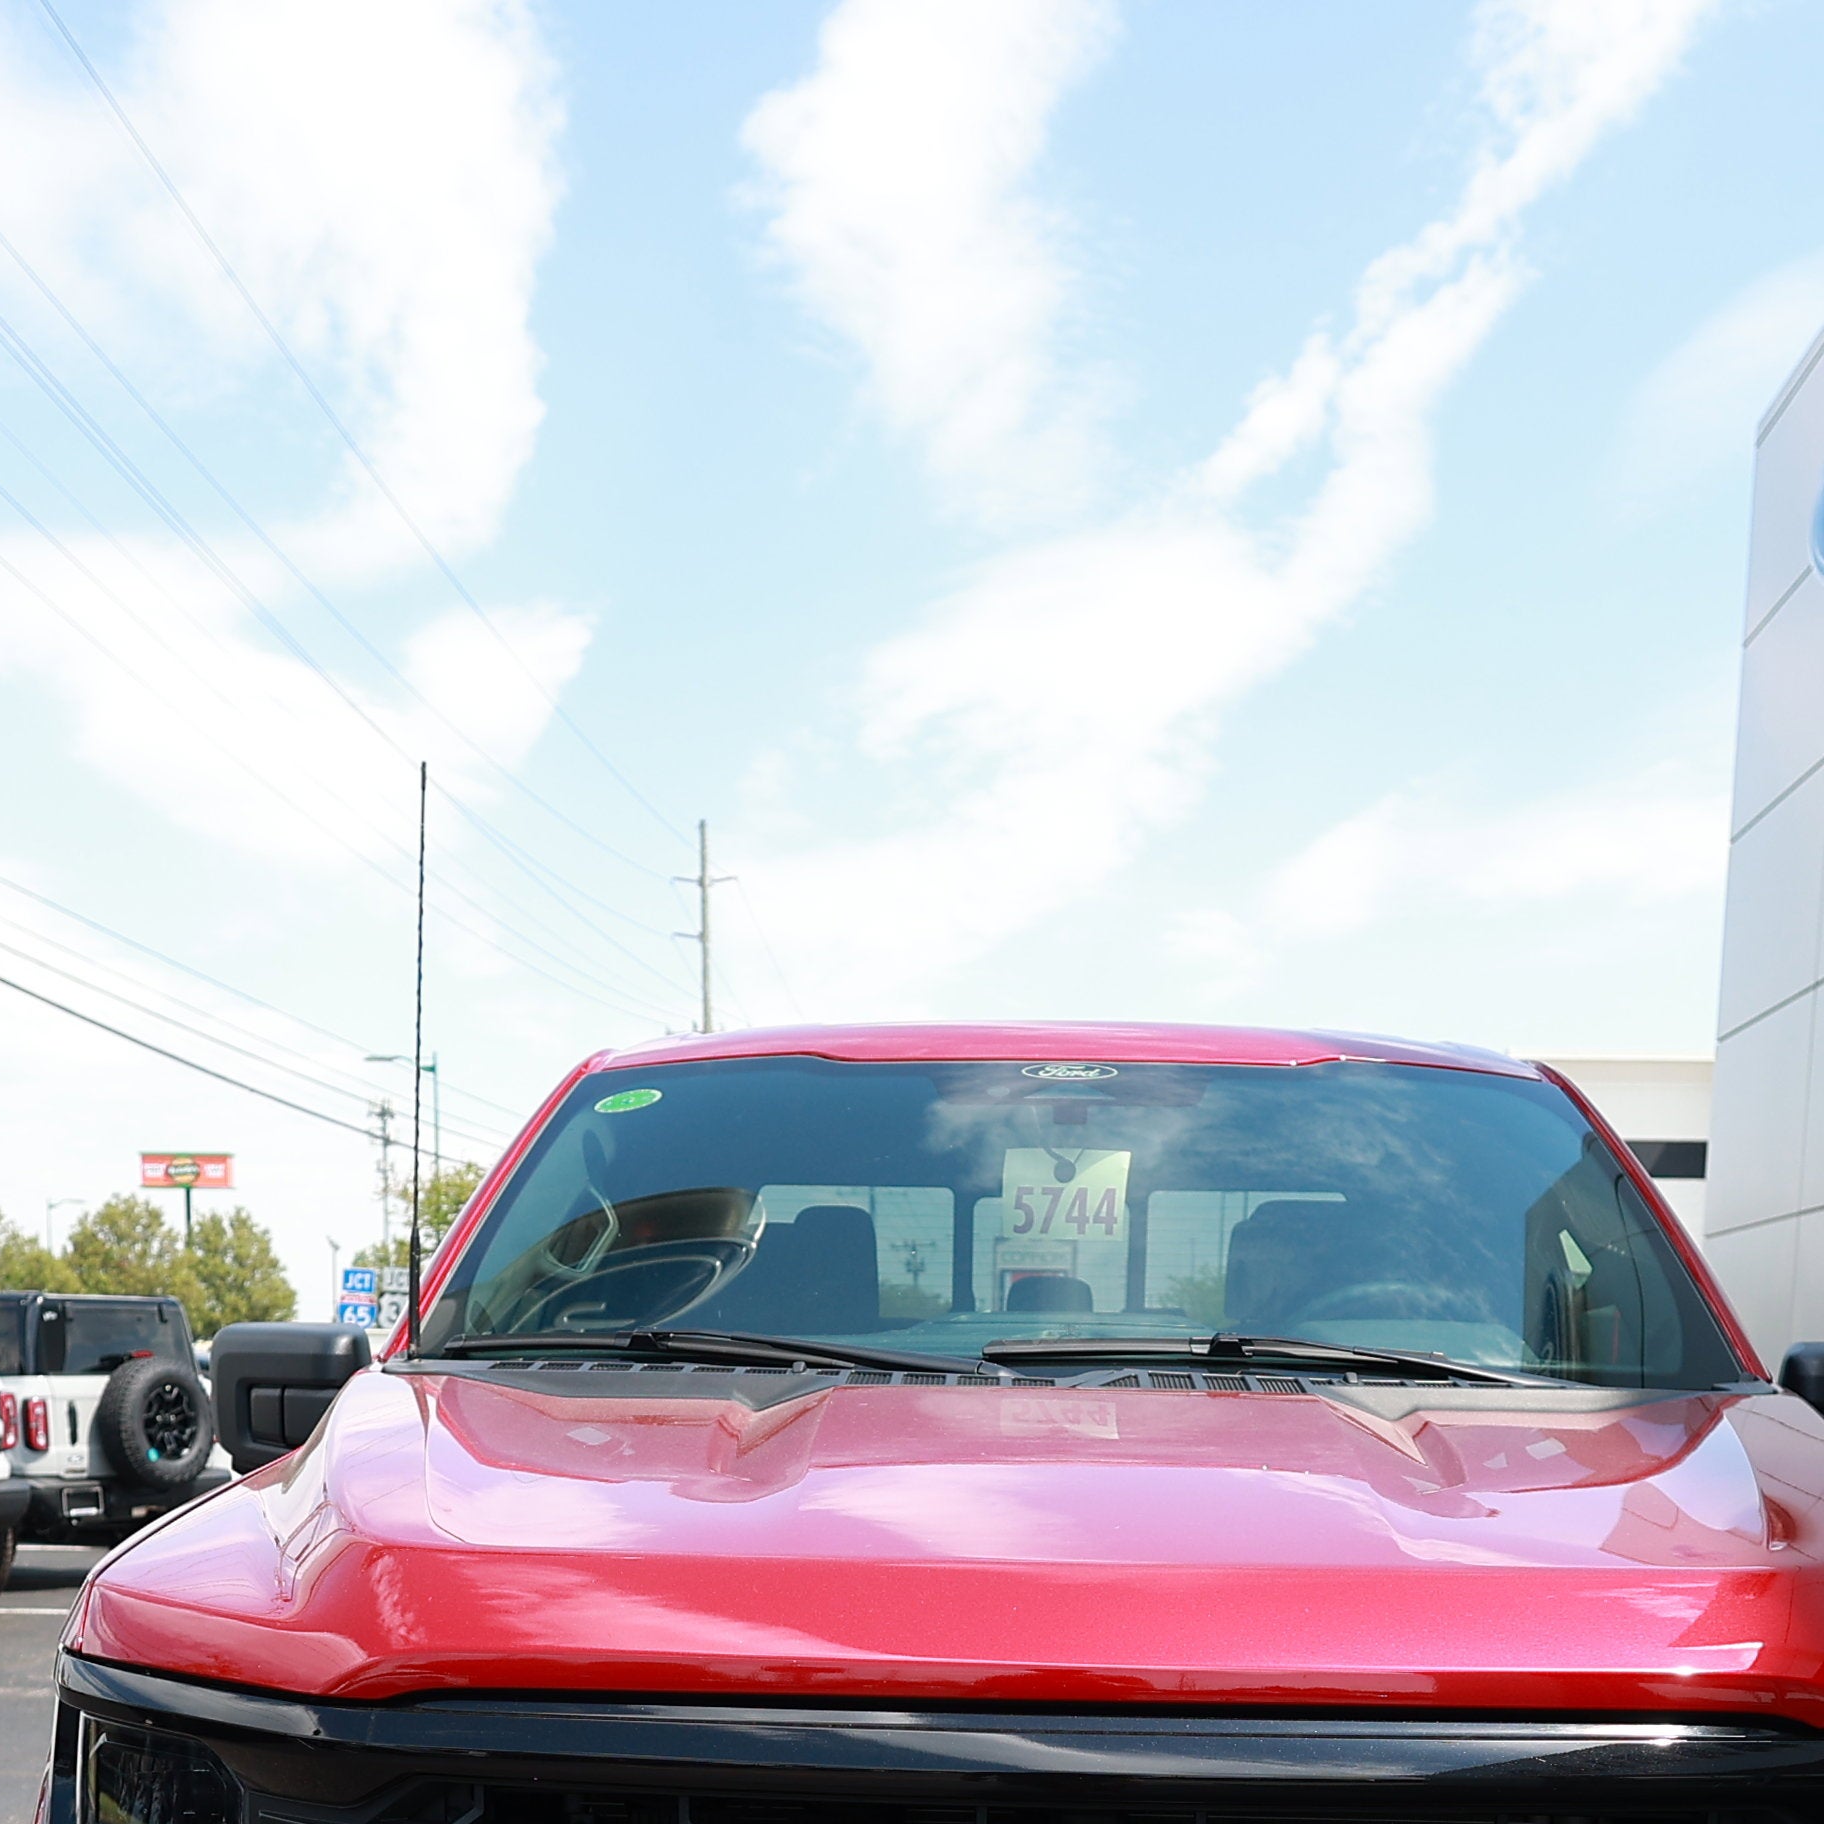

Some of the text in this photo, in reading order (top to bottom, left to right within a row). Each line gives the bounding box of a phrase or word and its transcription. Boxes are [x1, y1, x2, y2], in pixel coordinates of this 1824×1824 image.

[1038, 1064, 1101, 1078] Ford
[1012, 1186, 1118, 1236] 5744
[345, 1272, 371, 1289] JCT
[387, 1270, 410, 1288] JC
[342, 1304, 373, 1327] 65
